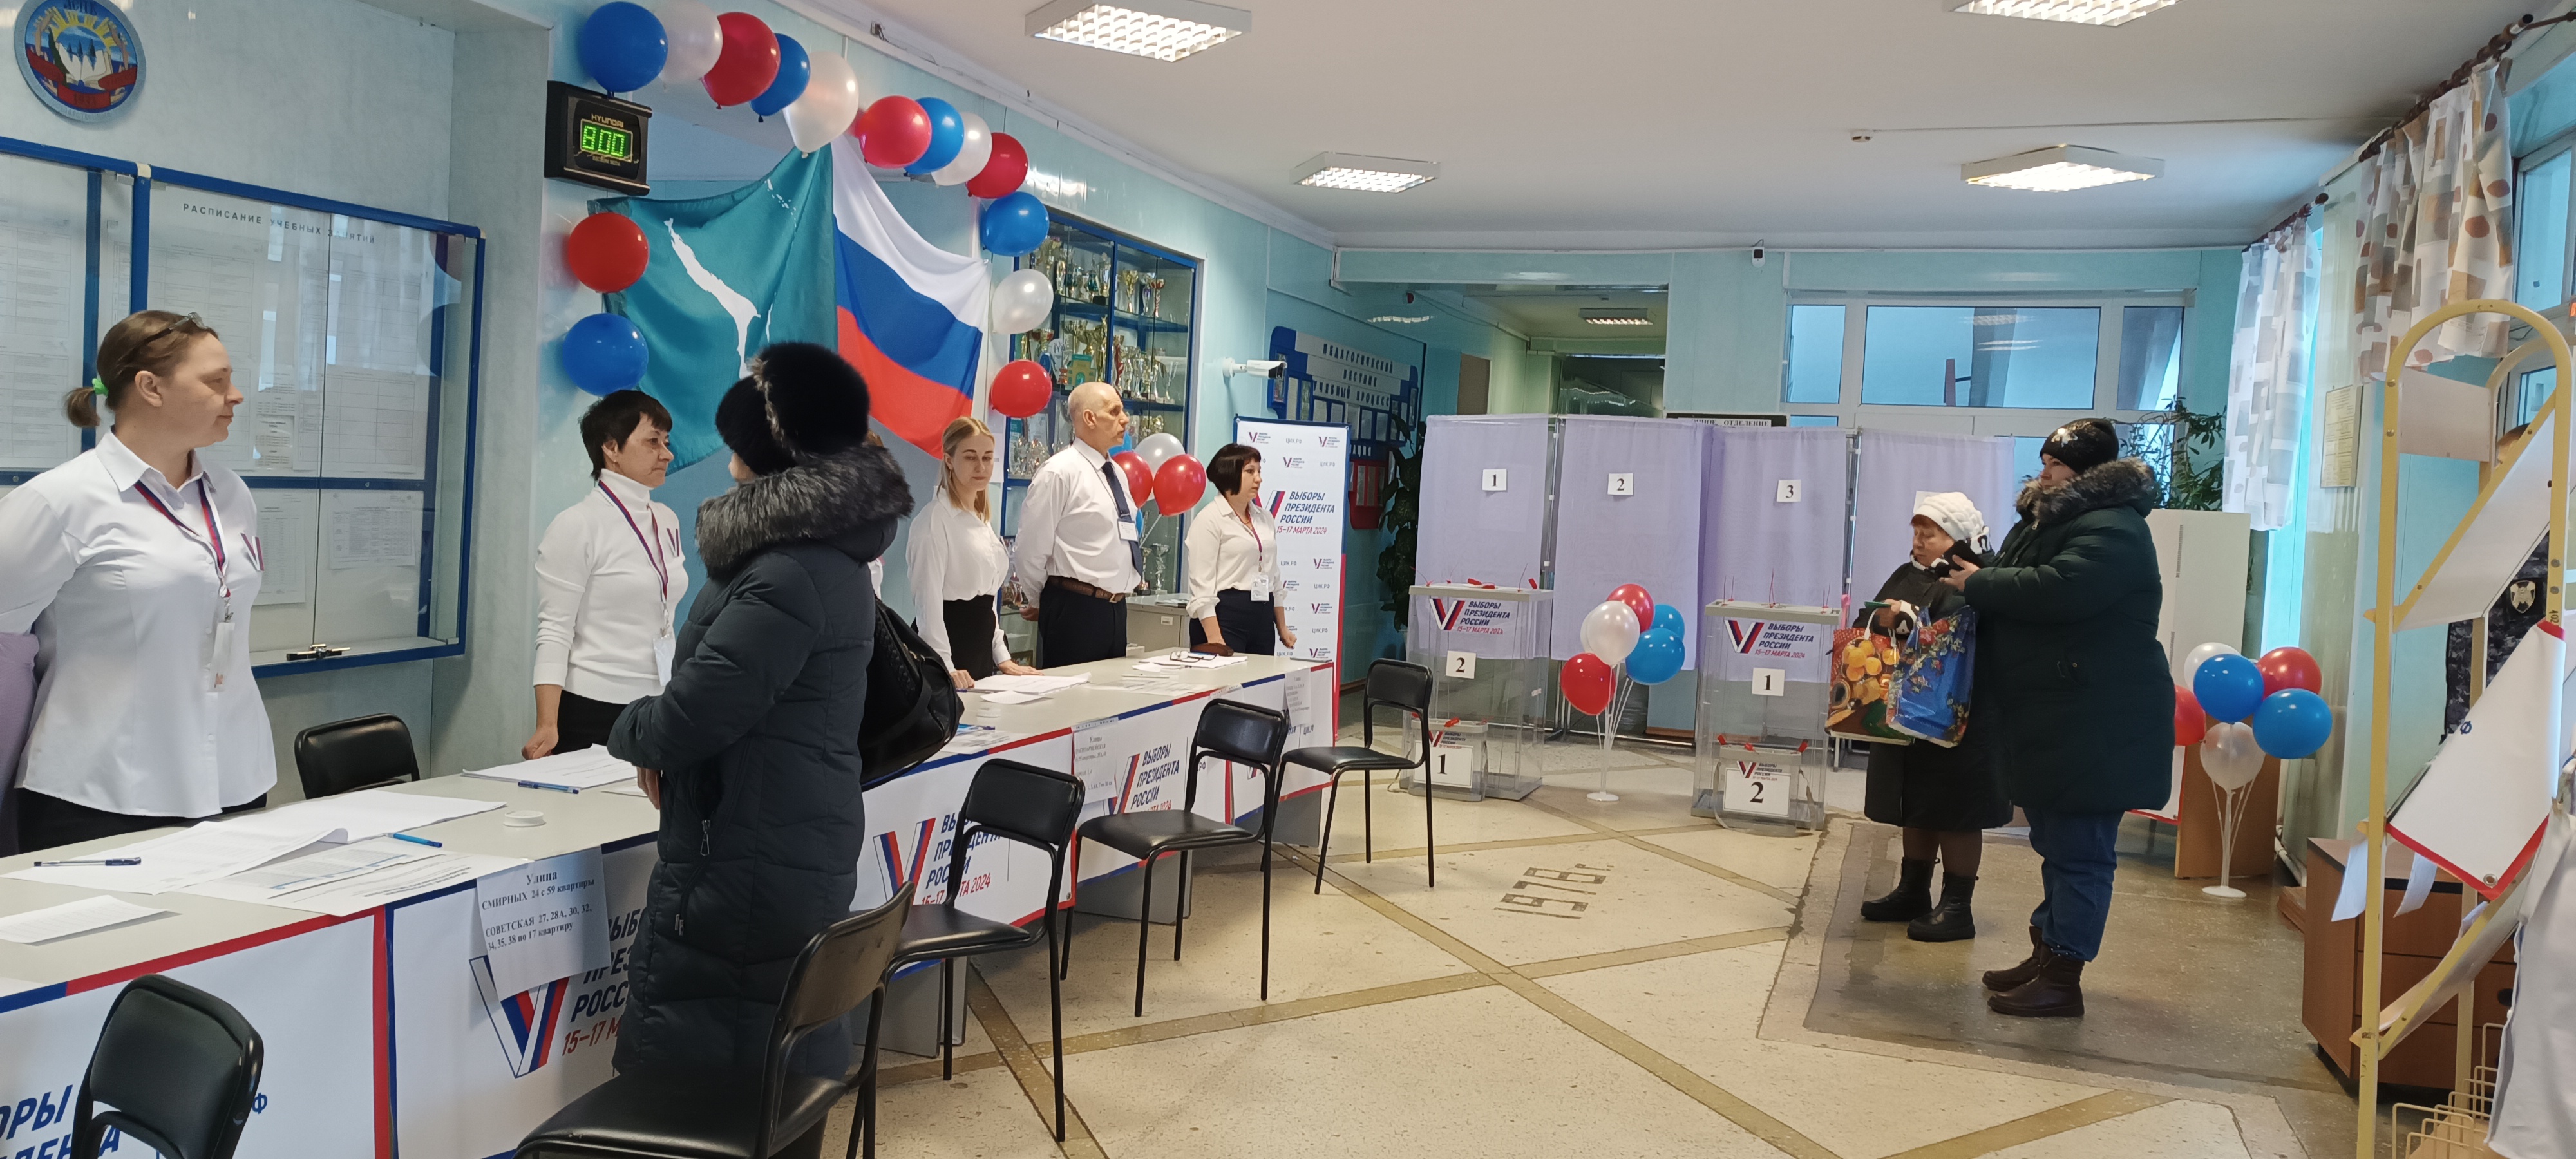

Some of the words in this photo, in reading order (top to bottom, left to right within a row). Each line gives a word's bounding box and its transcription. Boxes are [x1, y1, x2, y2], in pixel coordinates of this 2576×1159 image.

[591, 113, 624, 128] HYUNDAI
[183, 203, 261, 224] РАСПИСАНИЕ
[270, 218, 321, 235] УЧЕБНЫХ
[1323, 343, 1393, 374] ПЕДАГОГИЧЕСКИЙ
[1343, 369, 1377, 388] ВЕСТНИК
[1356, 390, 1390, 407] ПРОЦЕСС
[1492, 474, 1497, 487] 1
[1617, 478, 1625, 491] 2
[1289, 491, 1325, 501] ВЫБОРЫ
[1785, 485, 1794, 498] 3
[1284, 503, 1335, 514] ПРЕЗИДЕНТА
[1280, 514, 1313, 524] РОССИИ
[1293, 526, 1312, 534] МАРТА
[1468, 601, 1501, 609] ВЫБОРЫ
[1460, 617, 1490, 626] РОССИИ
[1464, 608, 1510, 619] ПРЕЗИДЕНТА
[1768, 623, 1804, 632] ВЫБОРЫ
[1758, 641, 1792, 650] РОССИИ
[1763, 632, 1814, 643] ПРЕЗИДЕНТА
[1455, 657, 1465, 673] 2
[1764, 674, 1772, 691] 1
[1142, 743, 1172, 766] ВЫБОРЫ
[1437, 753, 1448, 775] 1
[1137, 760, 1180, 788] ПРЕЗИДЕНТА
[1130, 785, 1160, 810] РОССИИ
[1750, 781, 1764, 804] 2
[526, 871, 558, 885] Улица
[970, 872, 991, 893] 2024
[482, 891, 527, 910] СМИРНЫХ
[531, 889, 540, 899] 24
[547, 885, 555, 895] 59
[557, 878, 594, 893] квартиры
[1493, 867, 1607, 919] 1978
[486, 916, 535, 938] СОВЕТСКАЯ
[538, 913, 549, 923] 27,
[551, 910, 567, 921] 28А,
[569, 907, 580, 917] 30,
[581, 903, 592, 914] 32,
[488, 941, 497, 951] 34,
[497, 938, 507, 948] 35,
[508, 934, 516, 945] 38
[518, 934, 527, 942] по
[529, 930, 536, 939] 17
[538, 922, 573, 937] квартиру
